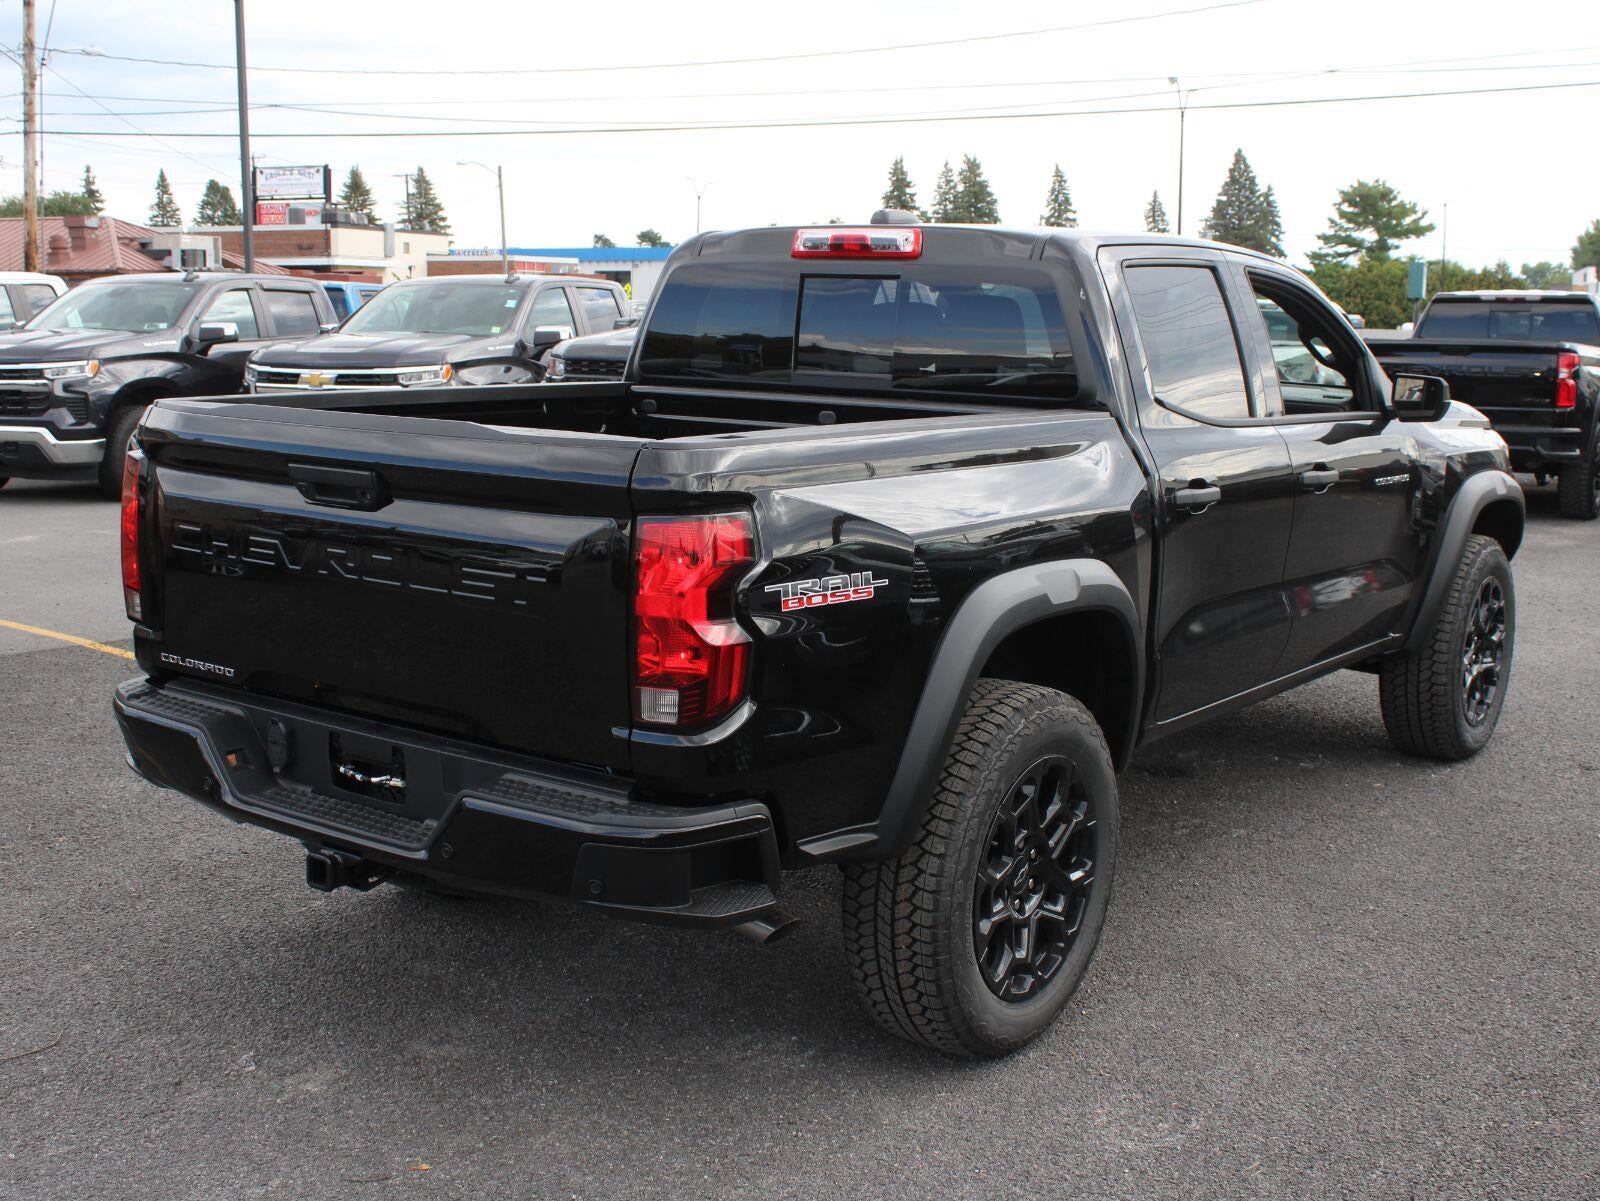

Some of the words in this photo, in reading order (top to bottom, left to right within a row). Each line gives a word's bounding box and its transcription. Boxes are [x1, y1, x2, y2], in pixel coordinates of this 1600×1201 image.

[261, 204, 285, 213] FAMILY
[171, 520, 548, 606] CHEVROLET
[764, 571, 889, 599] TRAIL
[781, 586, 875, 612] BOSS
[160, 652, 235, 678] COLORADO
